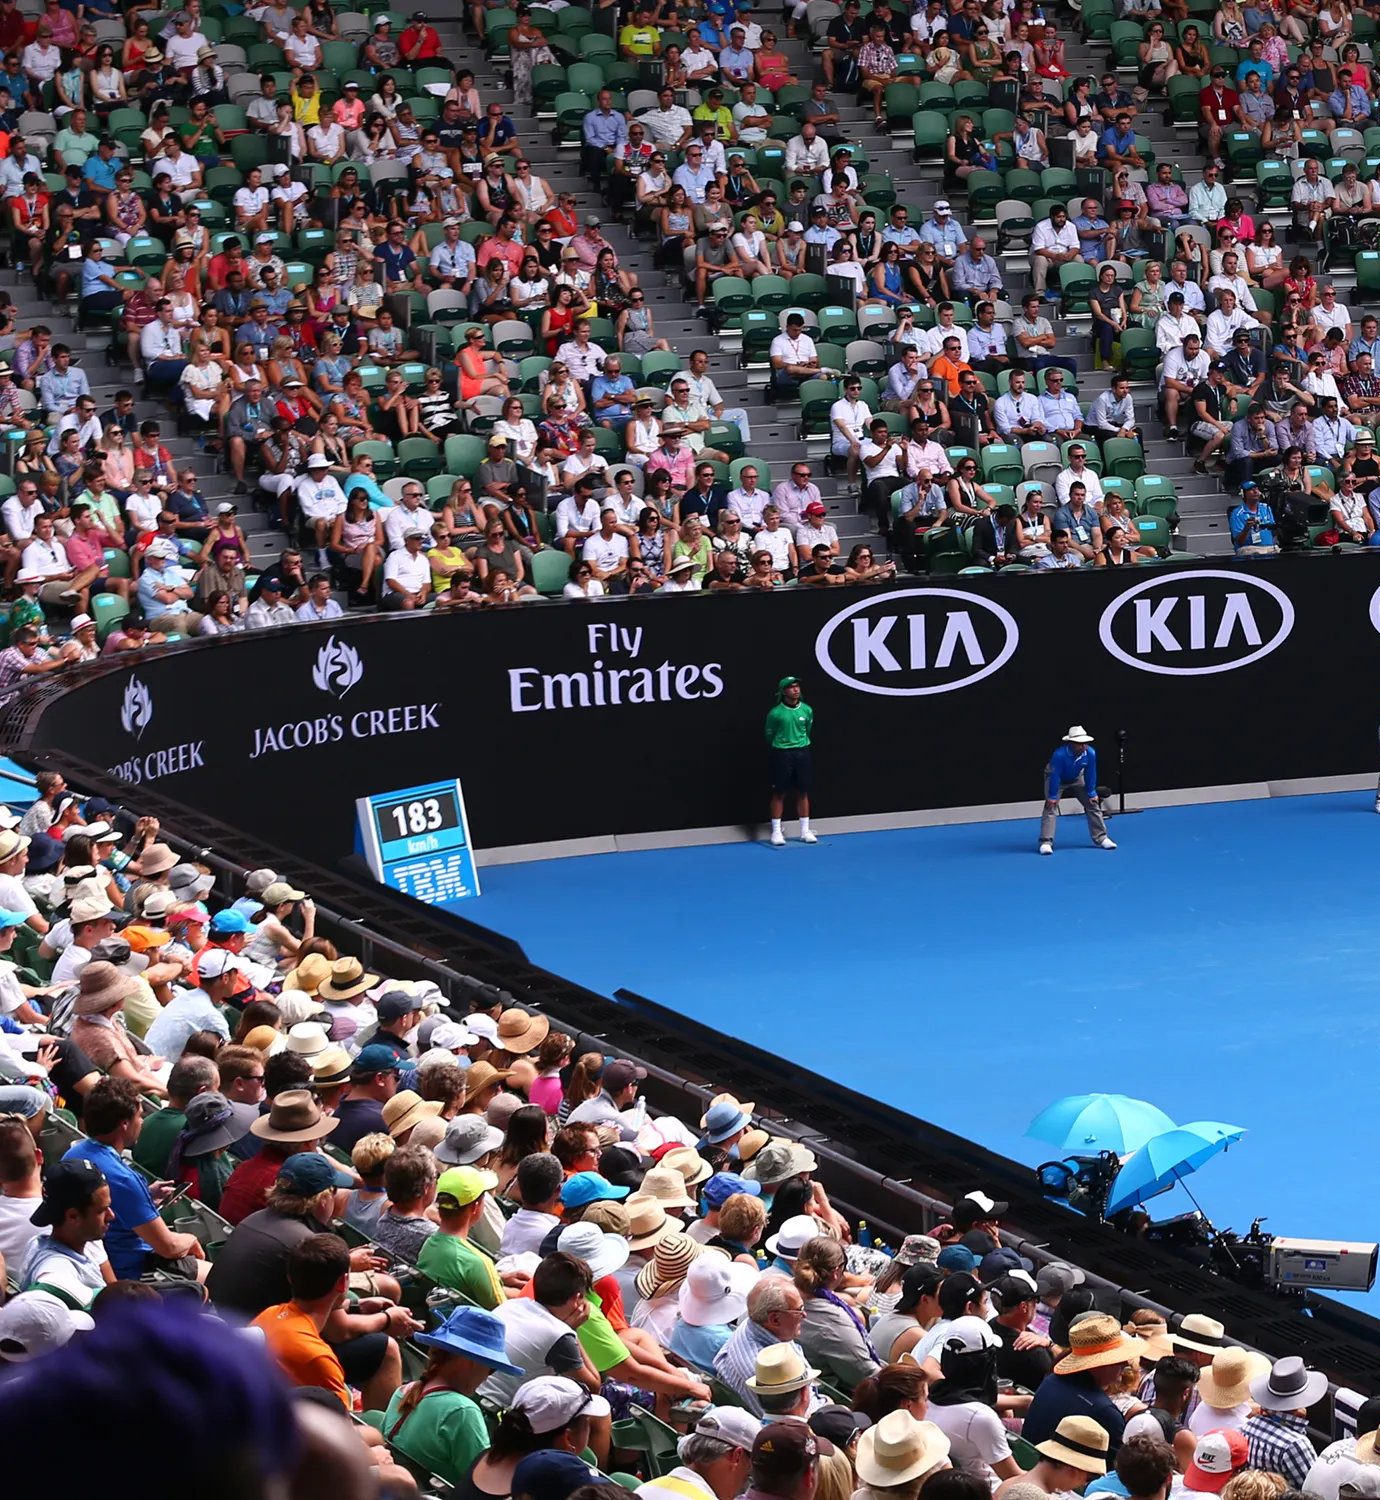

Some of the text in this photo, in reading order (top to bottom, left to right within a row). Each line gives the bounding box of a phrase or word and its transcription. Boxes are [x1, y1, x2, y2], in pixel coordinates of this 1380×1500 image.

[587, 622, 643, 658] Fly
[851, 610, 986, 674] KIA
[1133, 592, 1262, 653] KIA
[507, 660, 724, 713] Emirates
[249, 702, 440, 758] JACOB'S CREEK
[107, 740, 204, 785] OB'S CREEK
[392, 798, 443, 836] 183
[407, 834, 439, 855] km/h
[393, 855, 467, 904] IBM
